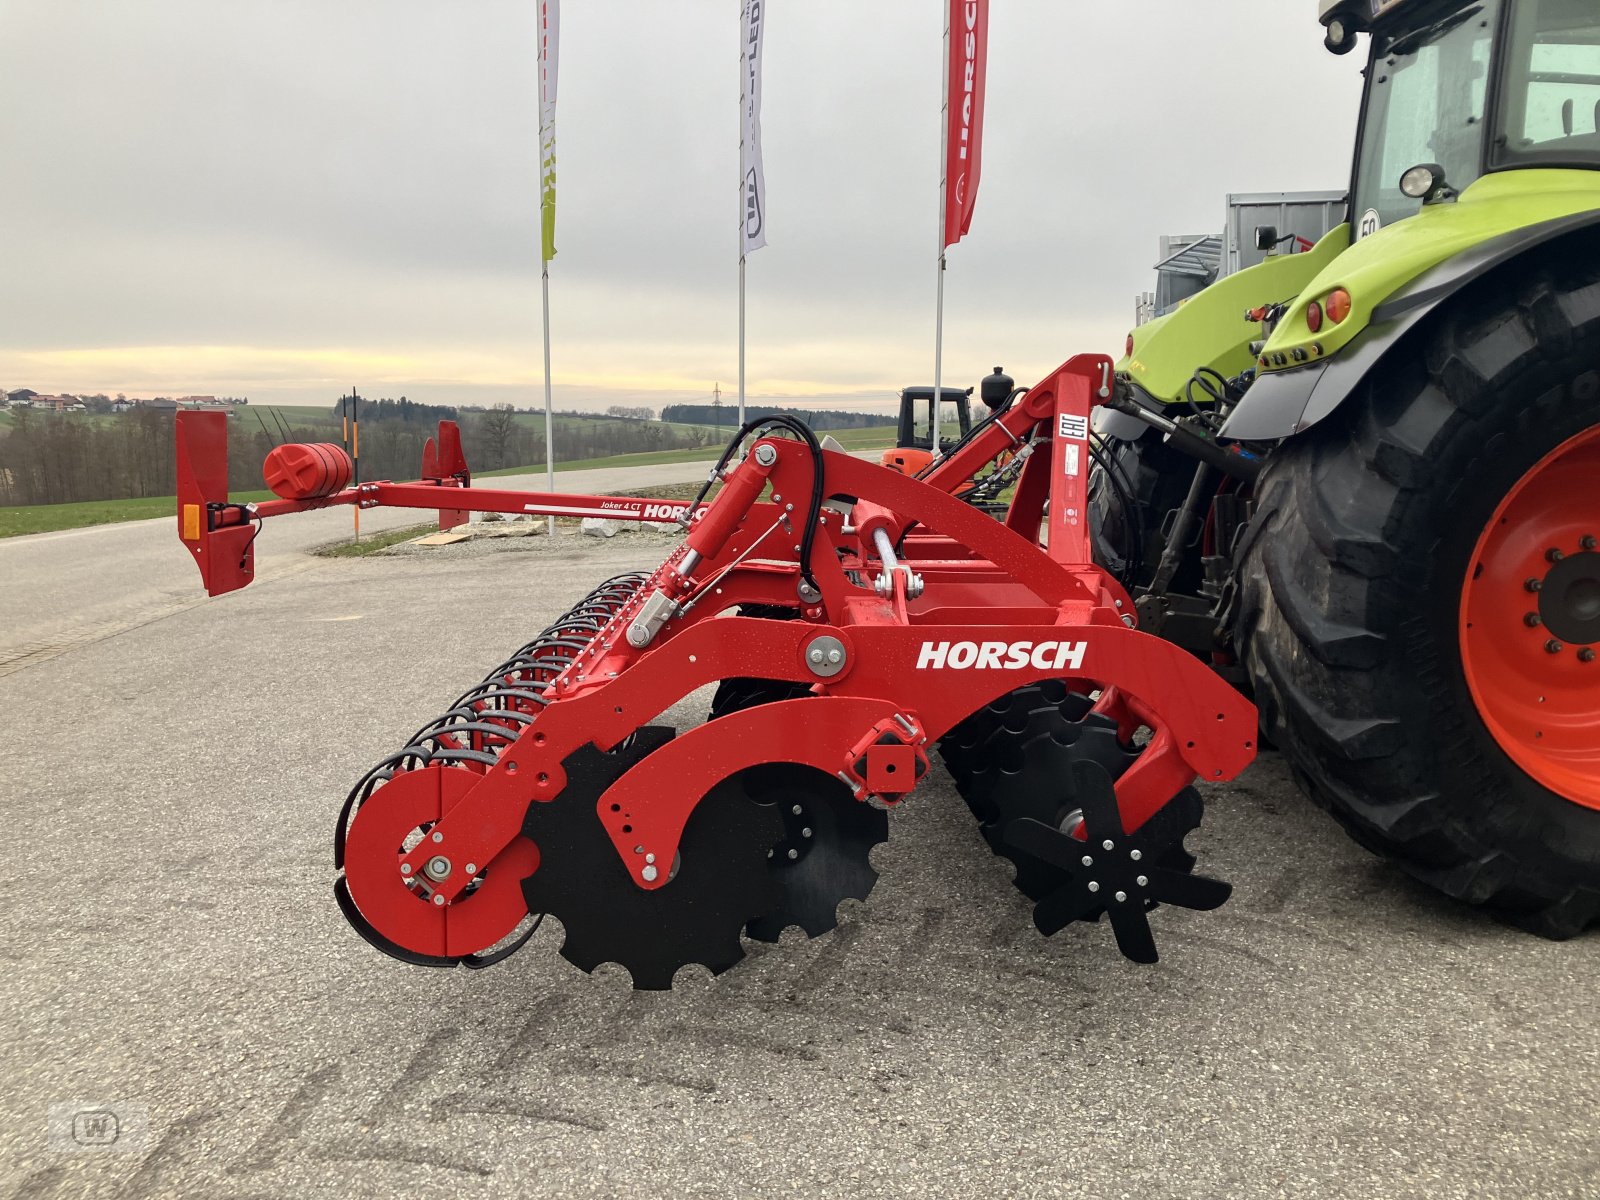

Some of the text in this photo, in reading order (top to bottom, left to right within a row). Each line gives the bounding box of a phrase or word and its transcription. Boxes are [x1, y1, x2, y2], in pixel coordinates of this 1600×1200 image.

[959, 0, 977, 160] HORSC
[1061, 415, 1085, 438] EAC
[601, 501, 622, 510] Joker
[623, 502, 630, 510] 4
[631, 503, 642, 511] CT
[916, 641, 1088, 670] HORSCH
